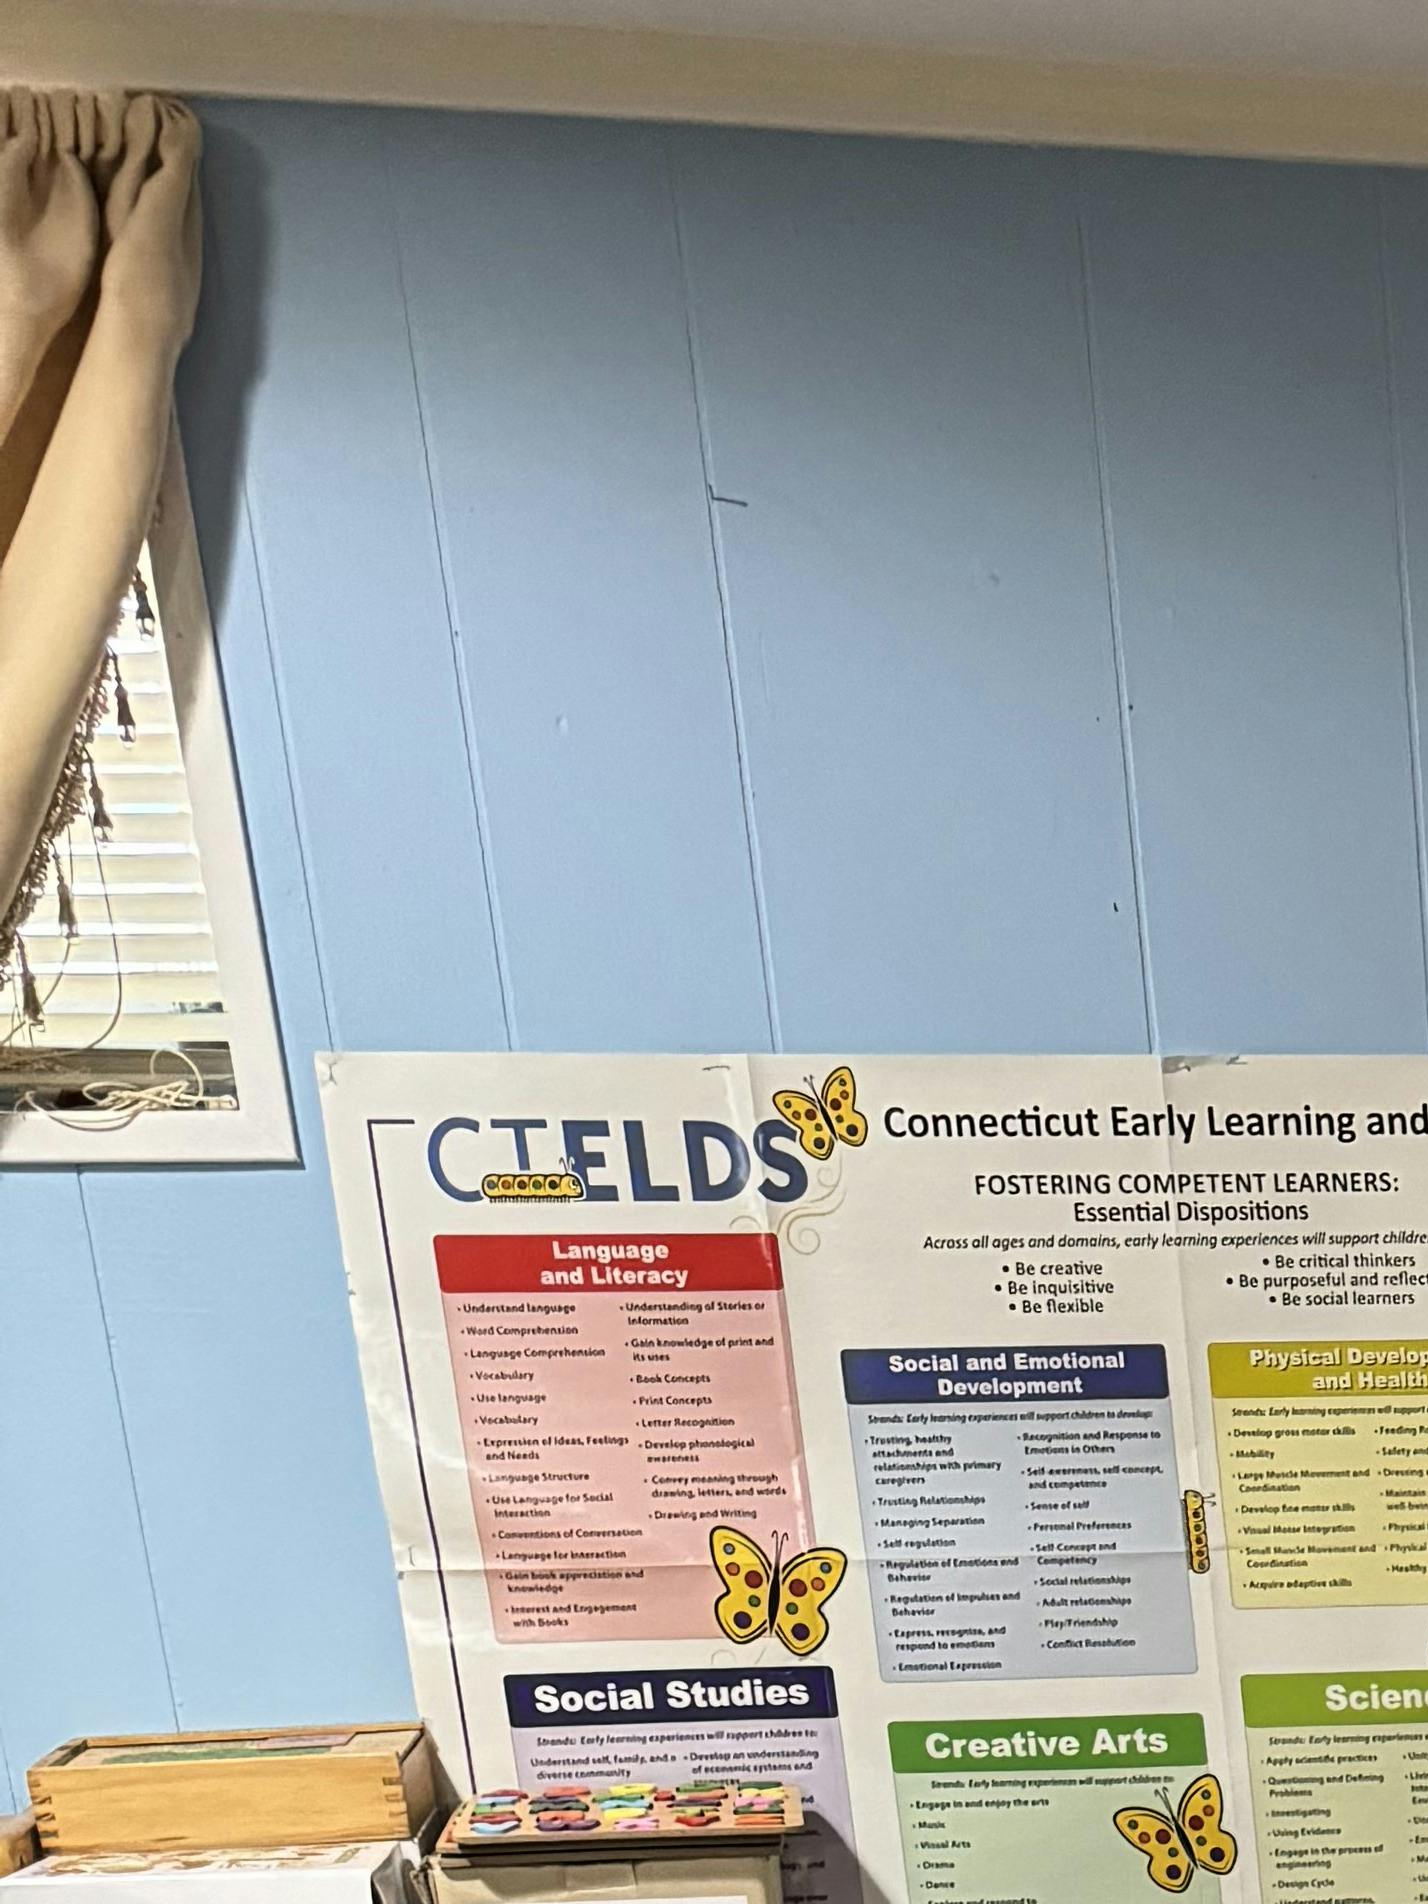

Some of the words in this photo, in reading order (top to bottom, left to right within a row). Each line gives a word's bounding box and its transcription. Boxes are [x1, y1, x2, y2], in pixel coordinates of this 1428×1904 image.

[885, 1106, 1099, 1137] Connecticut
[1111, 1104, 1195, 1143] Early
[1208, 1105, 1356, 1143] Learning
[1367, 1103, 1428, 1134] and
[975, 1174, 1110, 1194] FOSTERING
[1118, 1173, 1265, 1193] COMPETENT
[1274, 1172, 1398, 1192] LEARNERS:
[1074, 1201, 1169, 1221] Essential
[1177, 1200, 1308, 1224] Dispositions
[553, 1240, 668, 1263] Language
[923, 1236, 968, 1248] Across
[972, 1235, 989, 1248] all
[992, 1238, 1024, 1251] ages
[1028, 1235, 1054, 1248] and
[1058, 1234, 1120, 1249] domains,
[1124, 1233, 1158, 1249] early
[1162, 1233, 1217, 1249] learning
[1221, 1232, 1298, 1248] experiences
[1302, 1231, 1326, 1245] will
[1328, 1233, 1379, 1247] support
[1016, 1261, 1034, 1275] Be
[1040, 1260, 1102, 1275] creative
[1275, 1254, 1293, 1268] Be
[1299, 1253, 1348, 1267] critical
[1353, 1252, 1415, 1268] thinkers
[541, 1266, 583, 1284] and
[591, 1265, 687, 1288] Literacy
[1239, 1274, 1258, 1287] Be
[1263, 1272, 1346, 1293] purposeful
[1350, 1272, 1378, 1287] and
[1008, 1280, 1027, 1294] Be
[1033, 1279, 1113, 1300] inquisitive
[1282, 1290, 1300, 1305] Be
[1305, 1290, 1348, 1305] social
[1352, 1290, 1414, 1304] learners
[1022, 1300, 1041, 1313] Be
[1046, 1297, 1103, 1313] flexible
[889, 1354, 958, 1372] Social
[966, 1353, 1006, 1370] and
[1013, 1351, 1124, 1369] Emotional
[1250, 1347, 1339, 1370] Physical
[938, 1376, 1082, 1398] Development
[1312, 1371, 1350, 1392] and
[1358, 1370, 1427, 1391] Health
[534, 1682, 653, 1712] Social
[666, 1678, 809, 1708] Studies
[925, 1730, 1079, 1758] Creative
[1092, 1727, 1167, 1754] Arts
